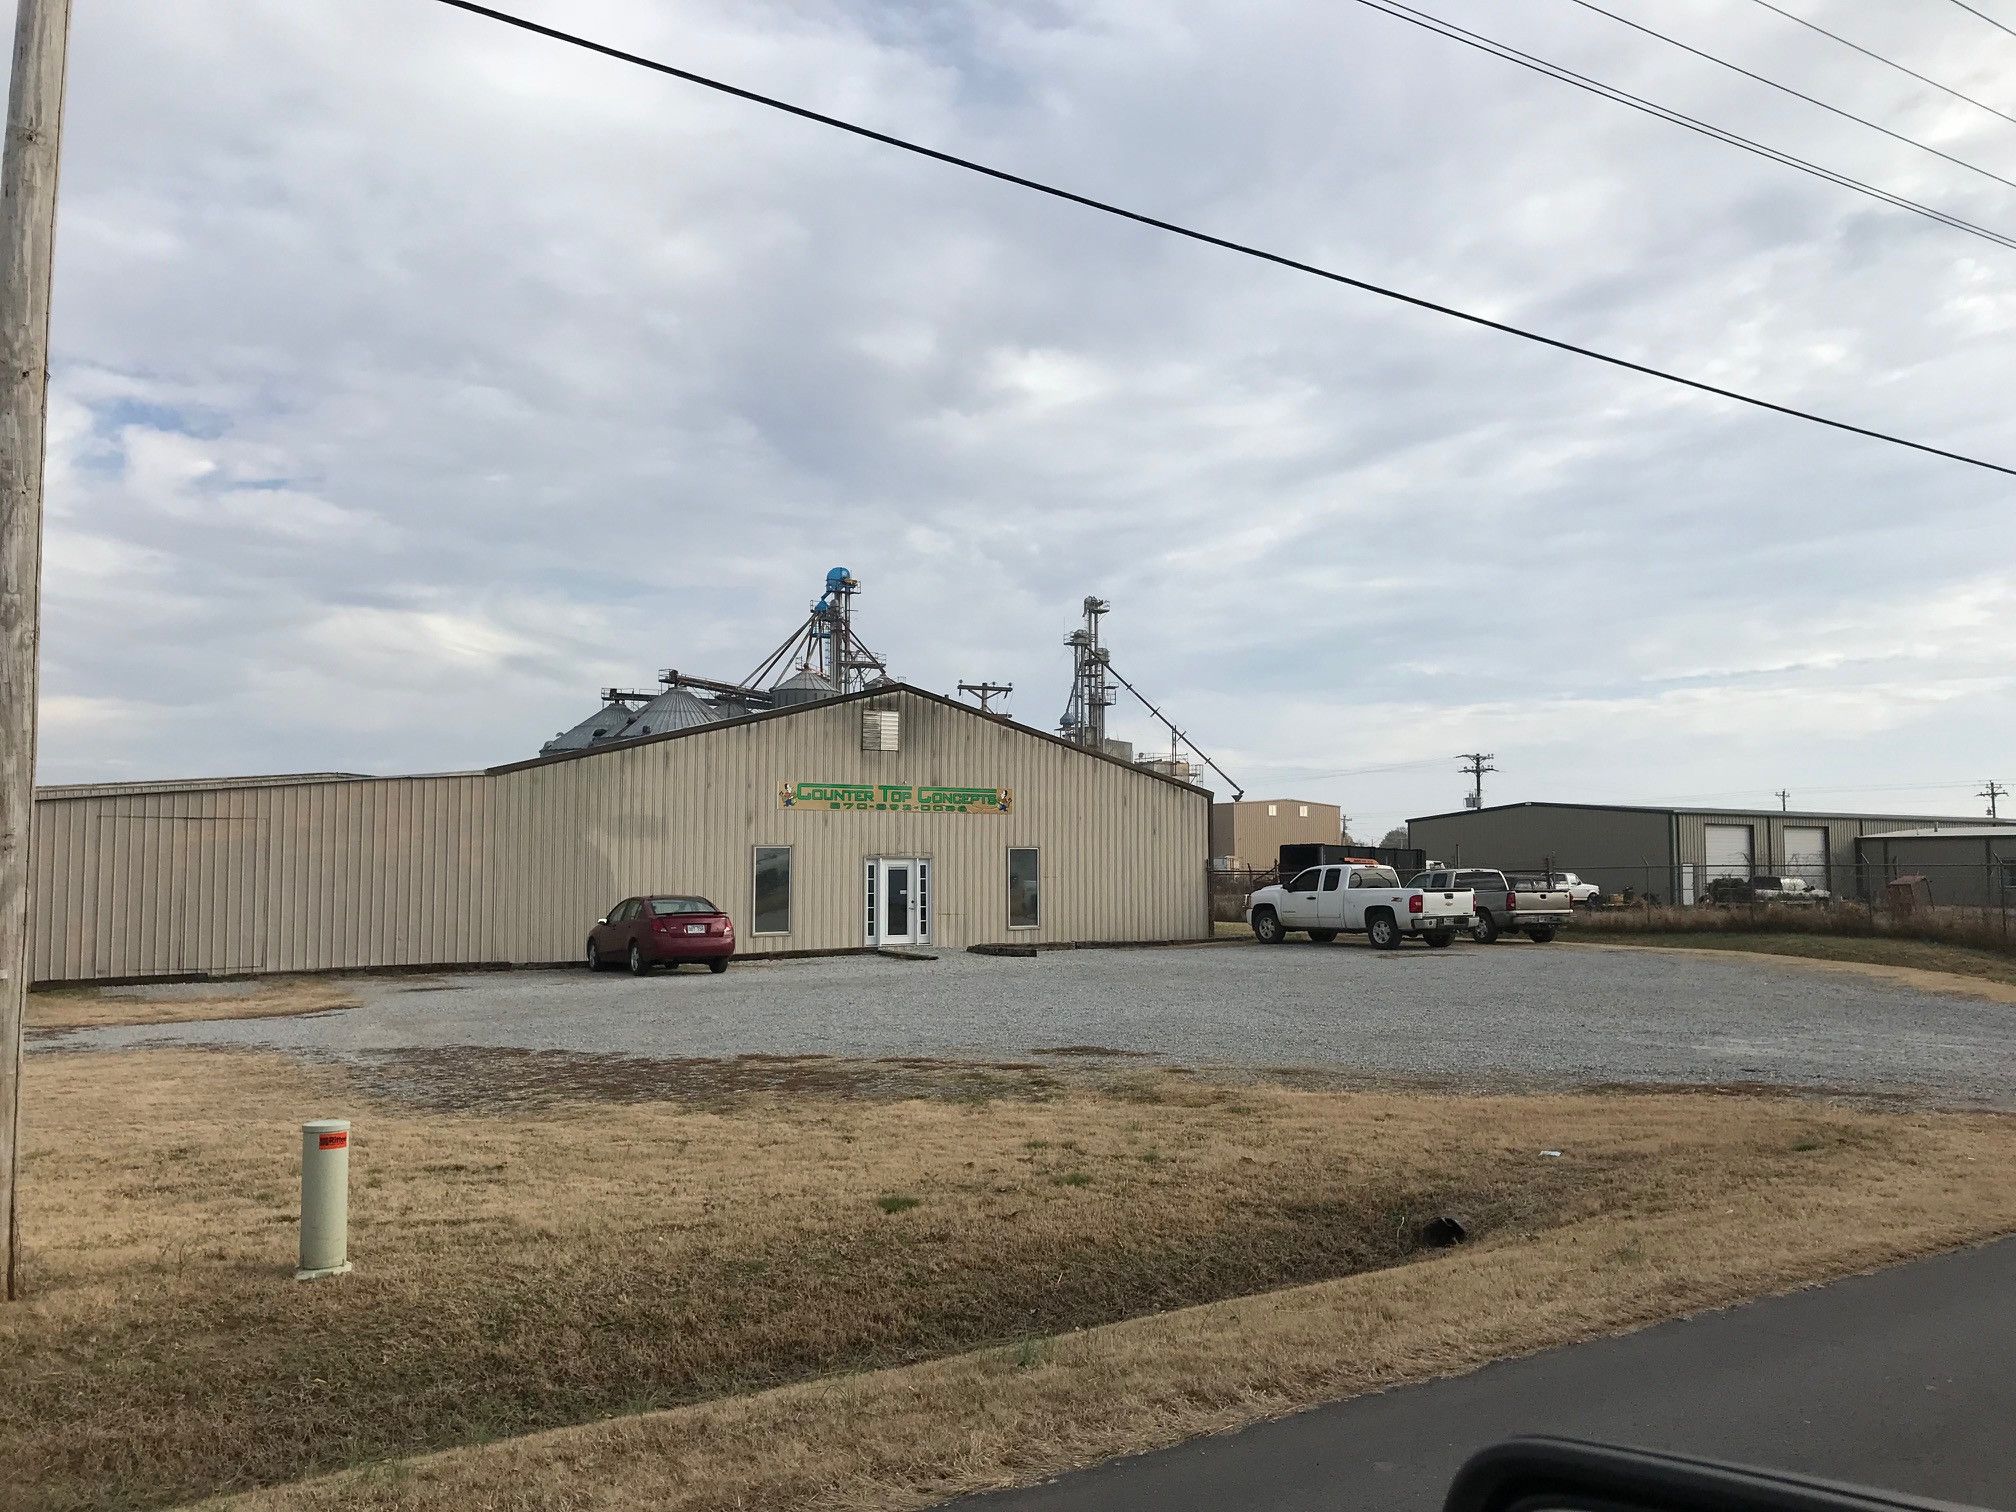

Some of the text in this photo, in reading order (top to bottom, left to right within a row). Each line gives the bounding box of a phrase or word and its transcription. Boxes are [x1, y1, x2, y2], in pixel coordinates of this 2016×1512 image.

[797, 783, 997, 805] COUNTER TOP CONCEPTS
